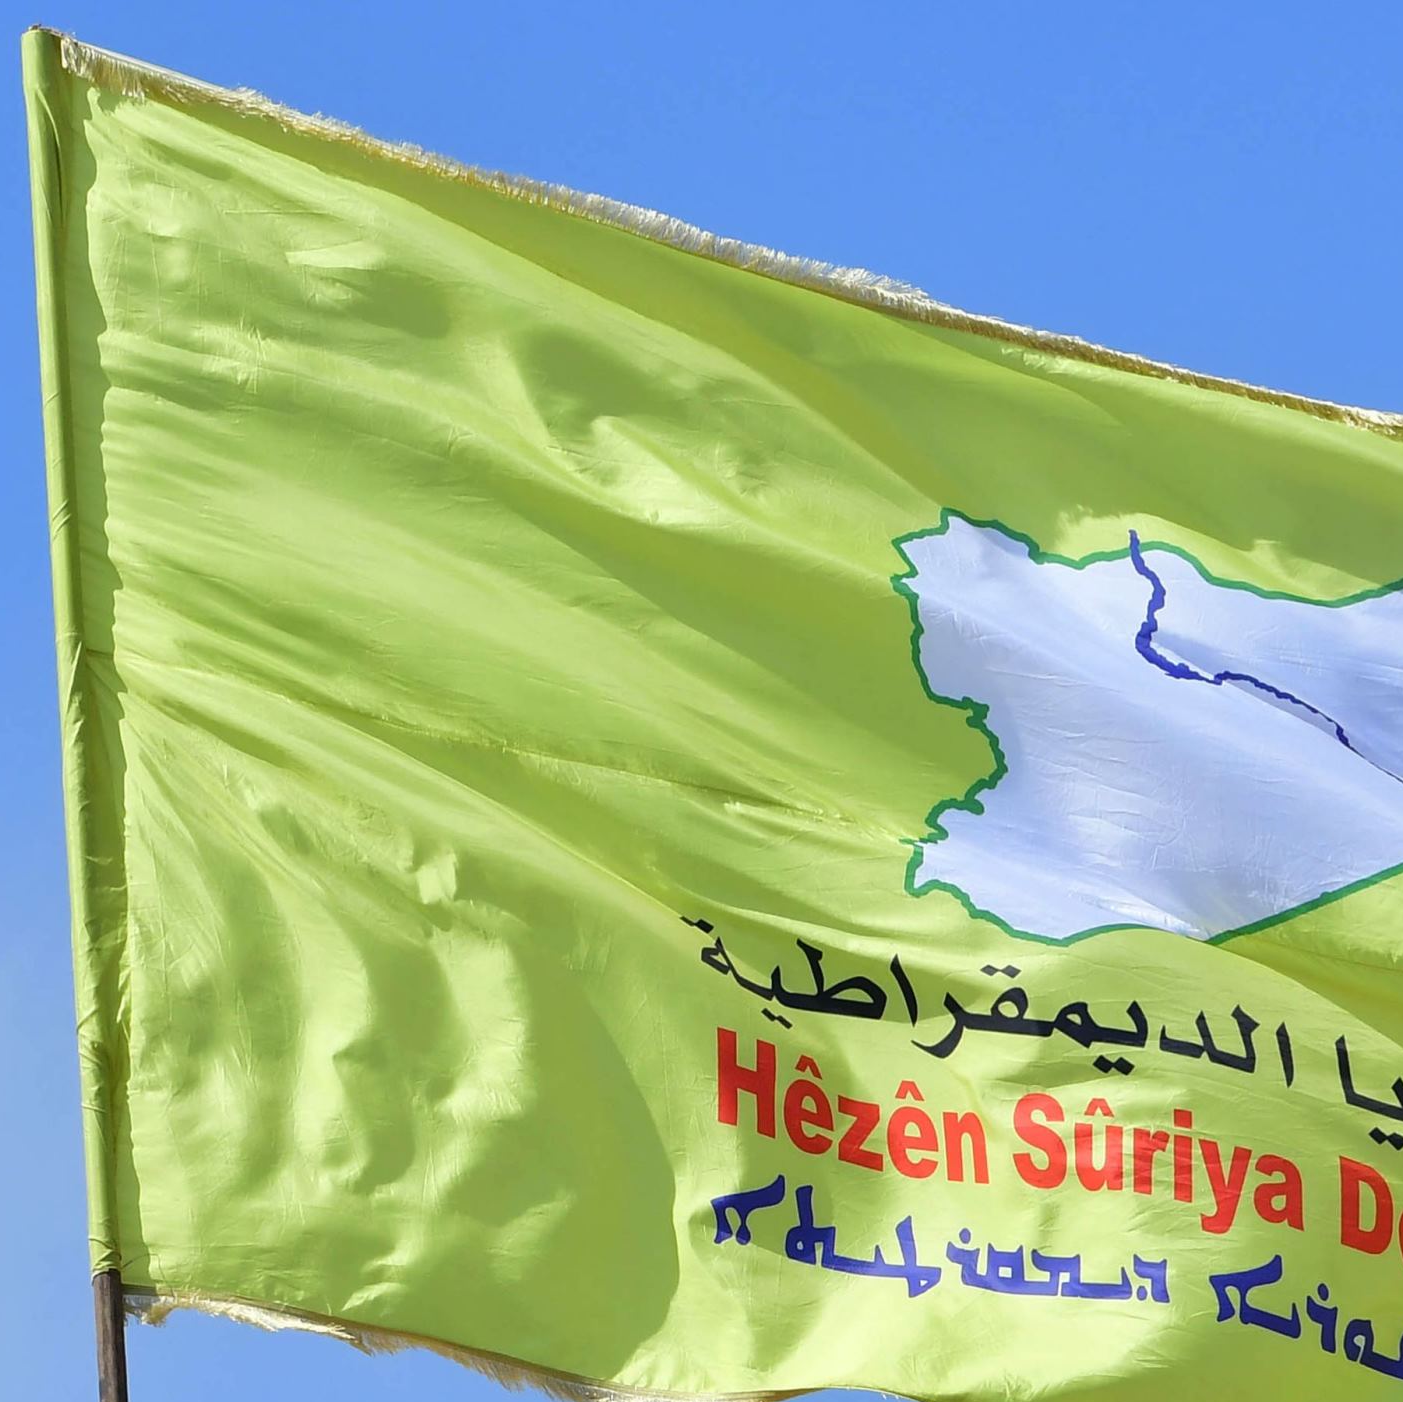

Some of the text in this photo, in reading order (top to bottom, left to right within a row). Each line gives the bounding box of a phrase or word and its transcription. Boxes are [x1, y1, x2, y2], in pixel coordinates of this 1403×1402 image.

[679, 916, 1295, 1087] الديمقراطية
[716, 1027, 990, 1185] Hêzên
[1012, 1092, 1305, 1236] Sûriya
